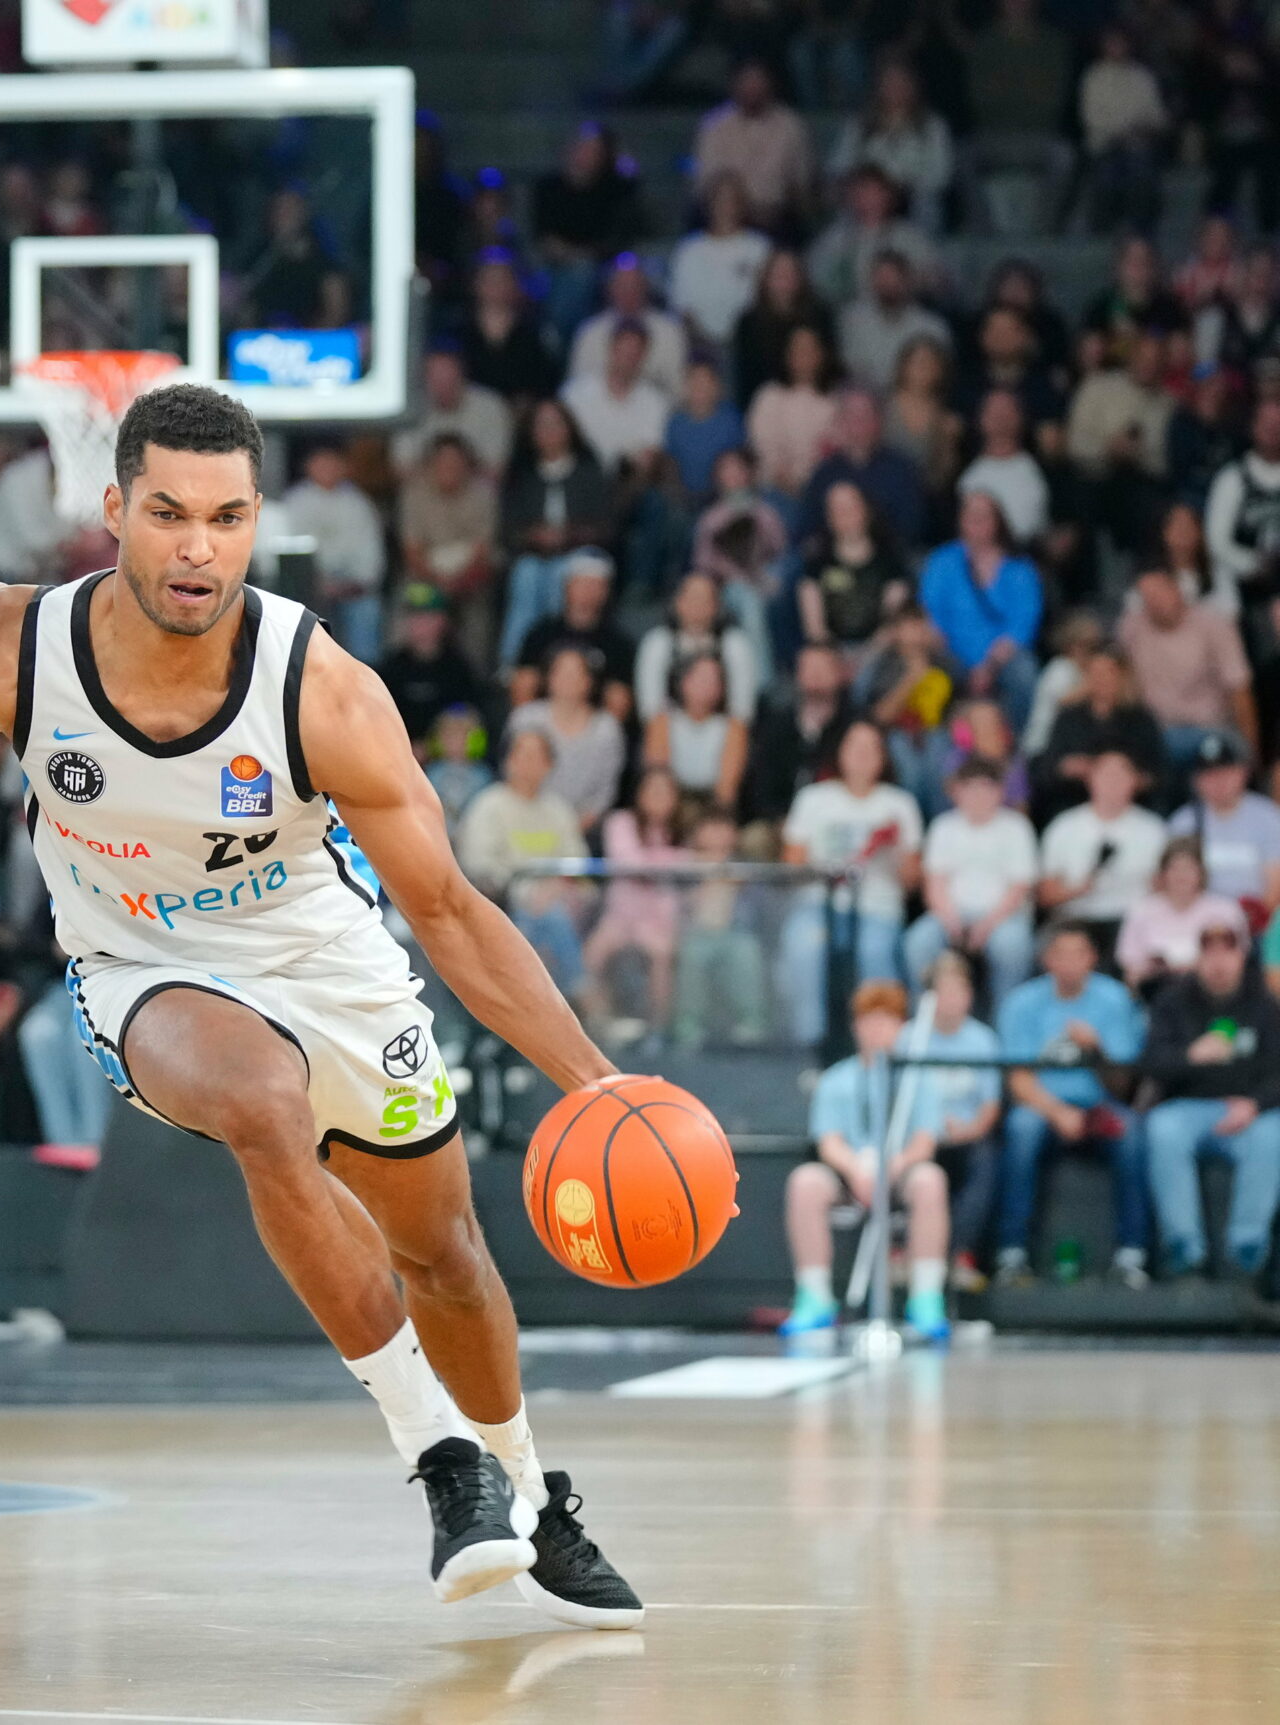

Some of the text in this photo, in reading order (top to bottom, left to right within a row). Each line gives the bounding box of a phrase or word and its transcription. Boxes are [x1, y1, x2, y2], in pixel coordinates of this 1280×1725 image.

[49, 753, 102, 781] VEOLIA TOWERS
[226, 799, 266, 813] BBL
[55, 821, 151, 858] VEOLIA
